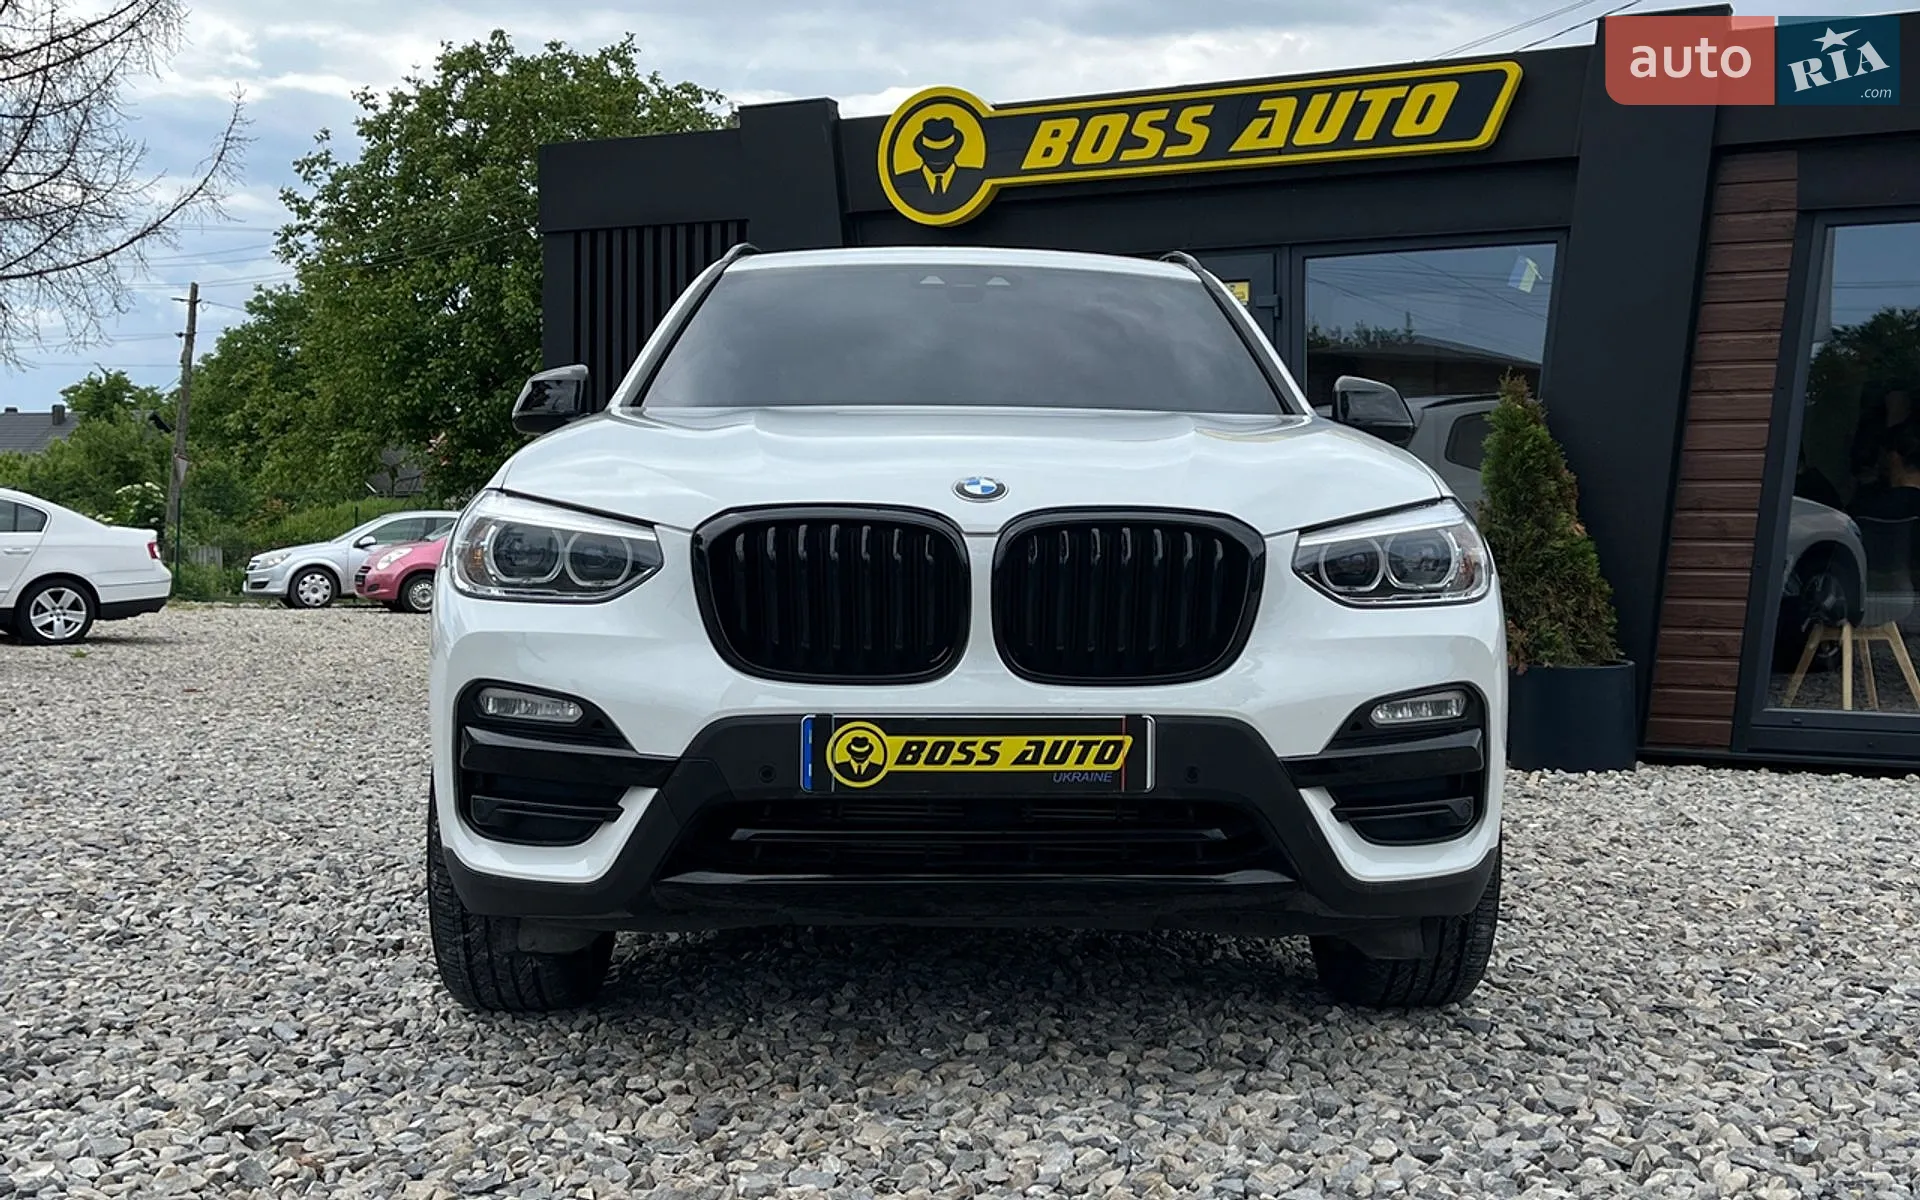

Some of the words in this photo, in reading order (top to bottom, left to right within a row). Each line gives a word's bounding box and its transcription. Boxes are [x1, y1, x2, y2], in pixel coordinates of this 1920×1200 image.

[1021, 104, 1214, 170] BOSS
[1229, 81, 1460, 152] AUTO
[894, 740, 1002, 766] BOSS
[1011, 740, 1124, 766] AUTO
[1053, 771, 1113, 783] UKRAINE
